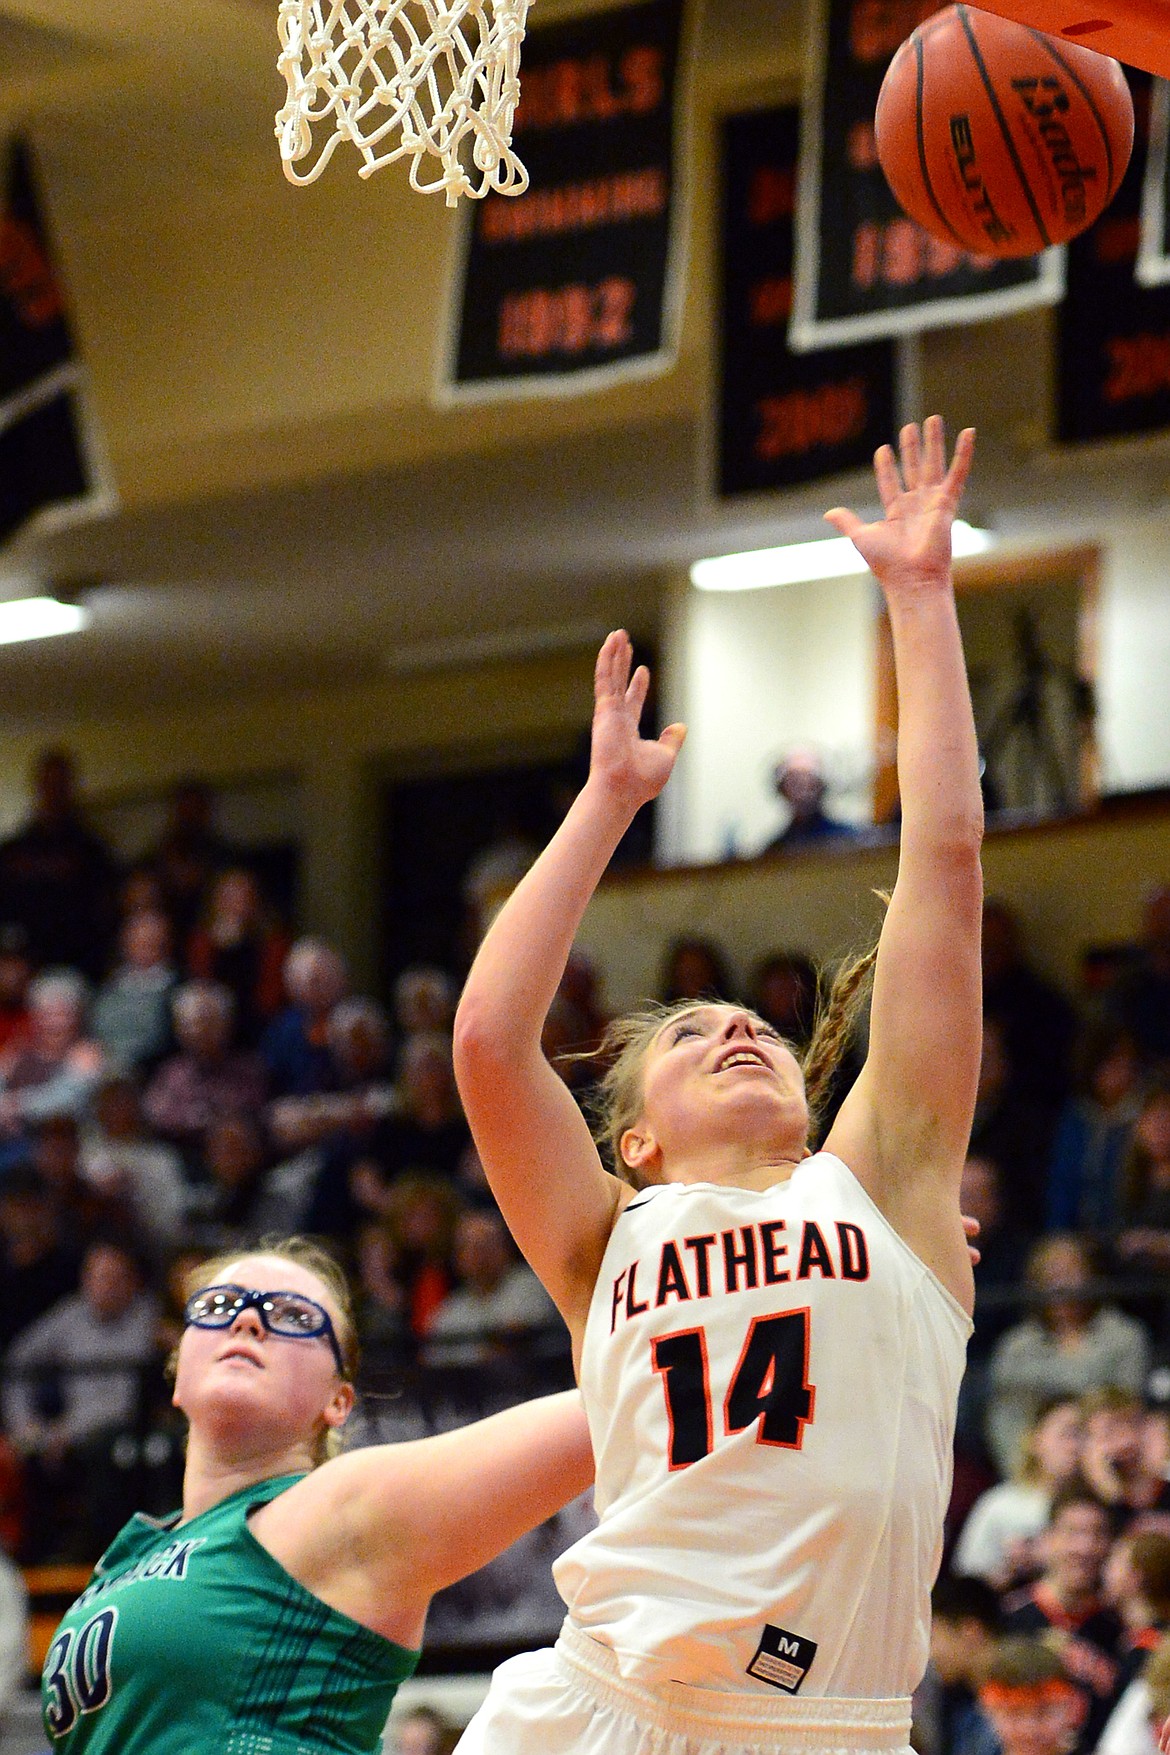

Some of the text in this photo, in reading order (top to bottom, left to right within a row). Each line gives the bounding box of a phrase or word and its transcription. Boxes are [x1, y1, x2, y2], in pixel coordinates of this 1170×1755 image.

[949, 111, 1013, 243] ELITE
[611, 1219, 871, 1335] FLATHEAD
[649, 1306, 816, 1472] 14
[42, 1605, 119, 1738] 30
[777, 1636, 800, 1658] M
